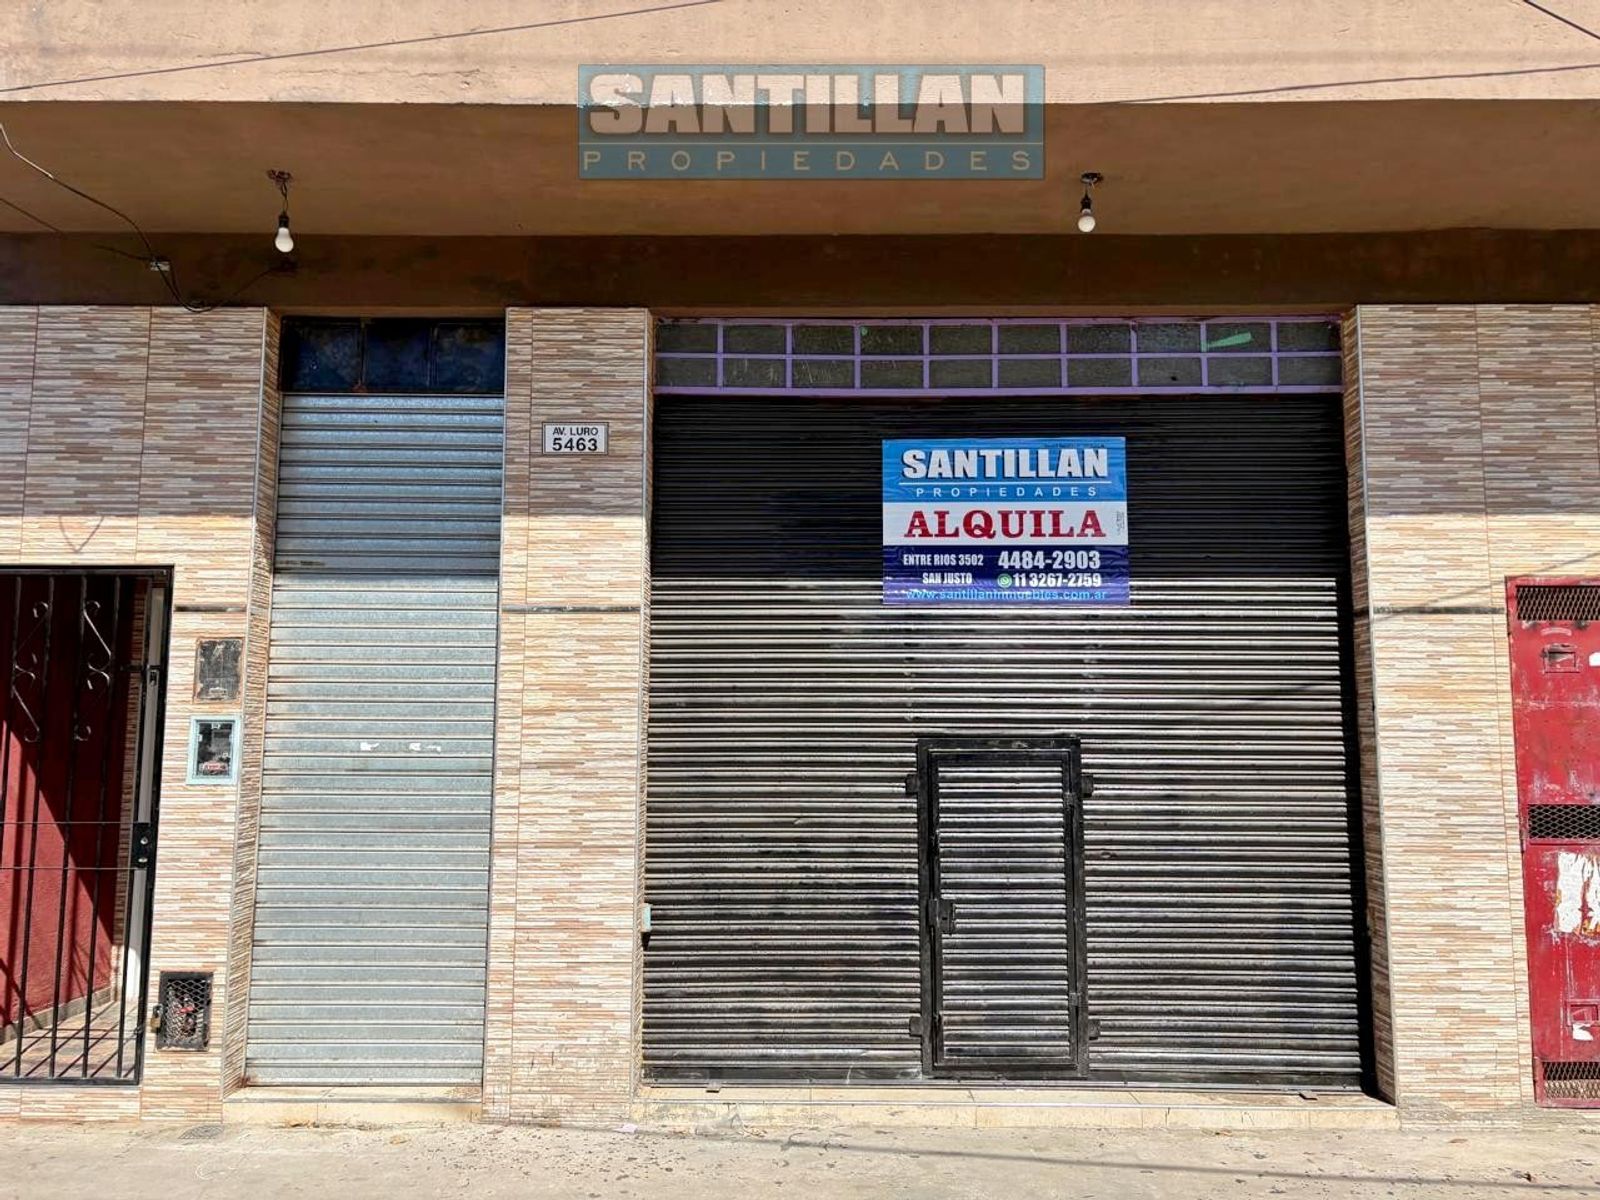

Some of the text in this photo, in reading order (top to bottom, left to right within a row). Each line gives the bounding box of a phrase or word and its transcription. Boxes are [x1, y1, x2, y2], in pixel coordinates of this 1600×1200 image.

[552, 427, 599, 436] AV. LURO
[552, 437, 598, 451] 5463
[902, 448, 1108, 479] SANTILLAN
[916, 486, 1097, 498] PROPIEDADES
[904, 509, 1106, 539] ALQUILA
[903, 553, 984, 566] ENTRE RIOS 3502
[998, 550, 1101, 569] 4484-2903
[922, 572, 973, 584] SAN JUSTO
[1012, 573, 1102, 587] 11 3267-2759
